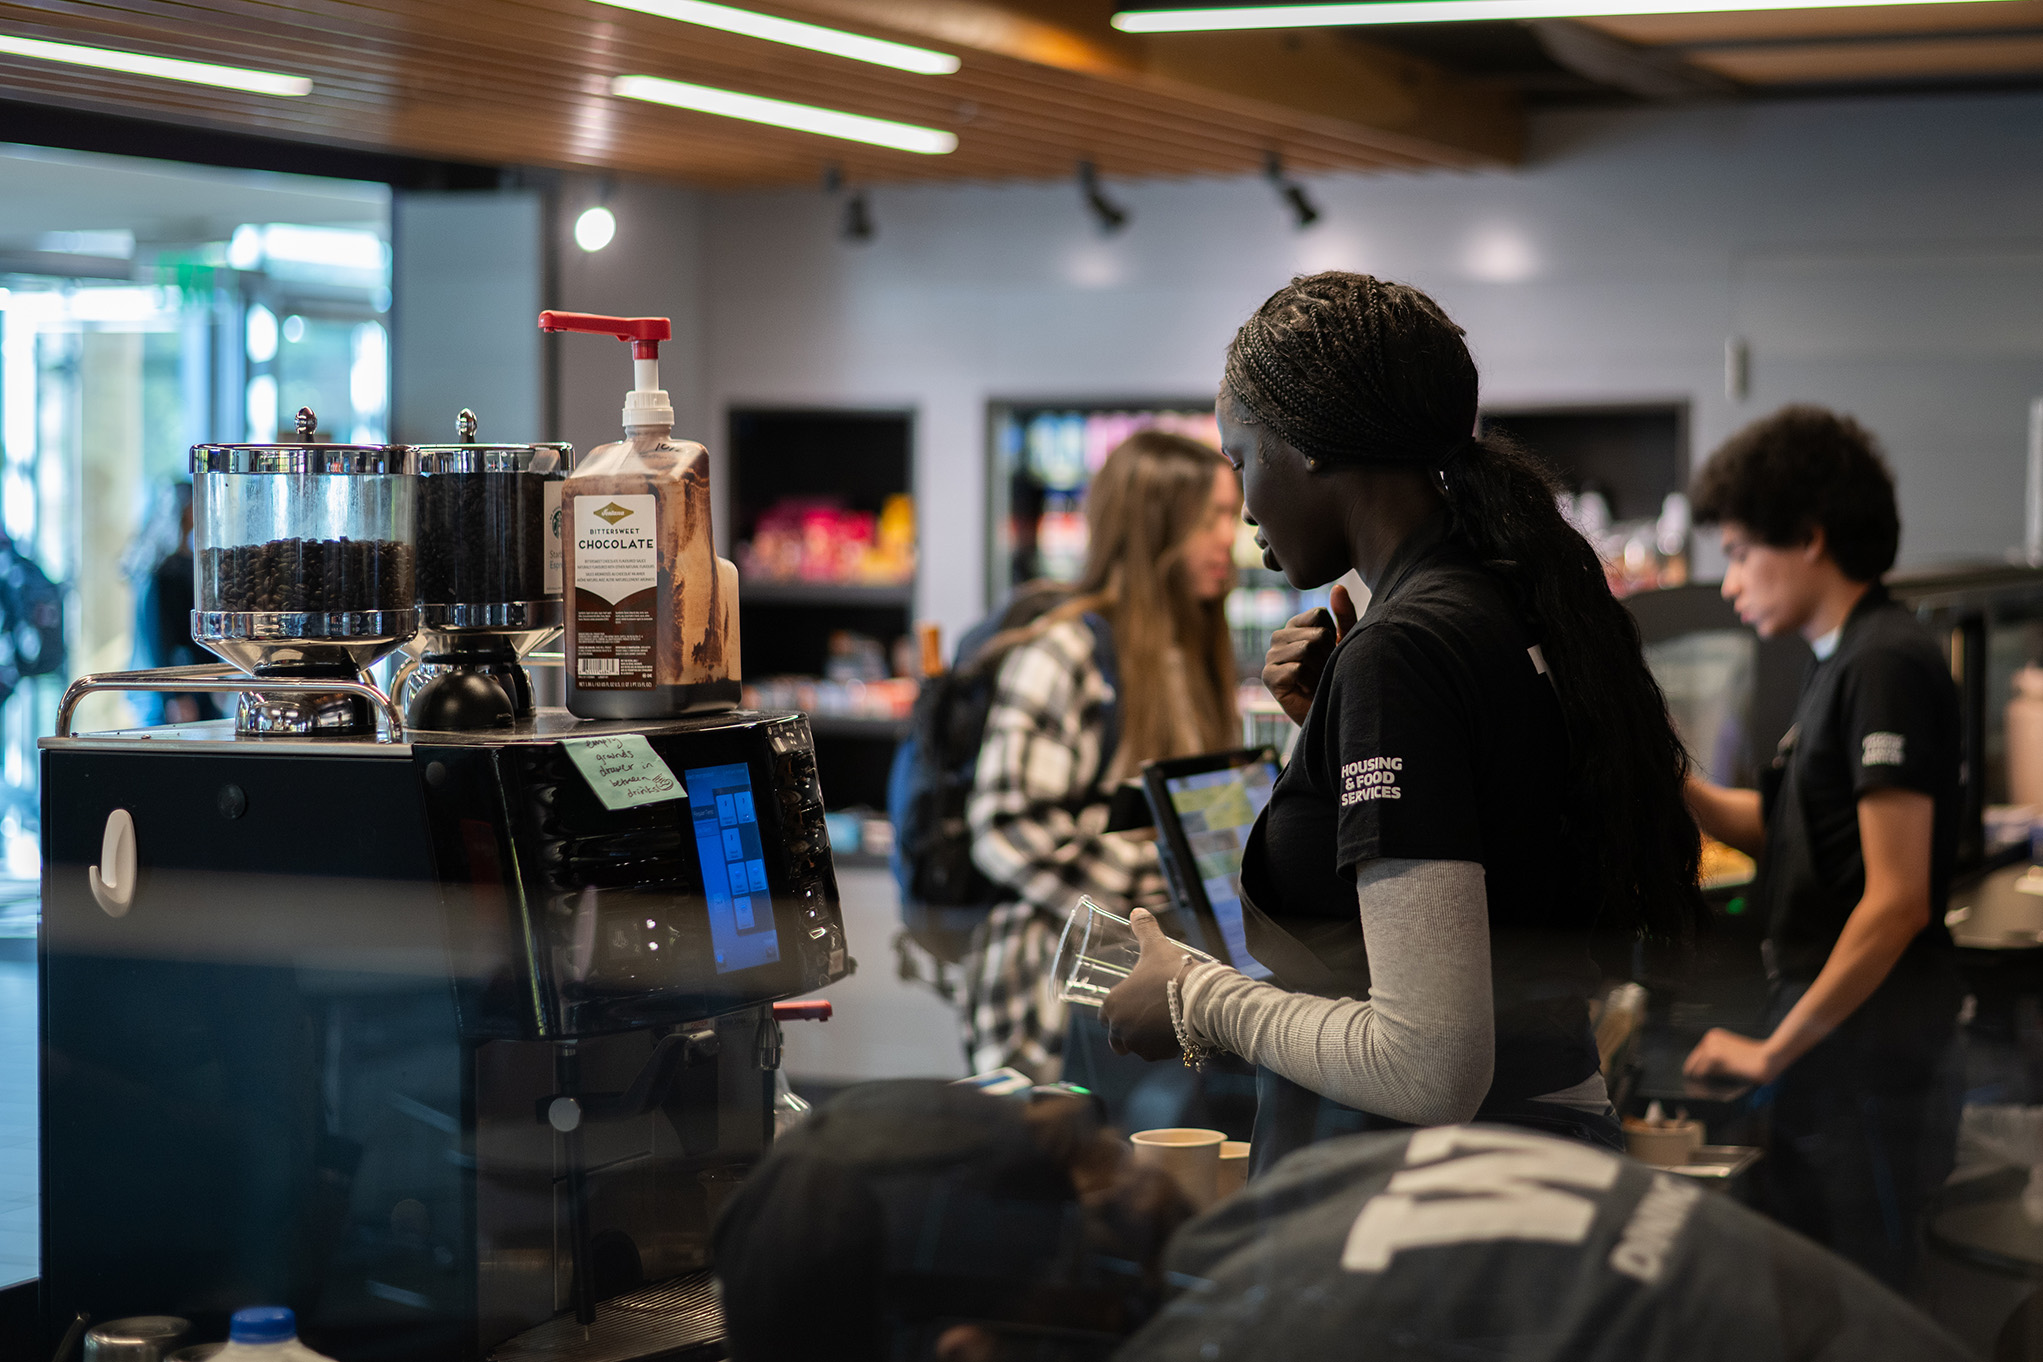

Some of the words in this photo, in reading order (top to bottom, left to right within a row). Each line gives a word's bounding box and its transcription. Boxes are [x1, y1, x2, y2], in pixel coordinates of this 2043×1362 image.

[578, 538, 654, 550] CHOCOLATE
[586, 737, 623, 749] empty
[599, 762, 634, 777] drawer
[642, 761, 654, 770] in
[1341, 757, 1402, 778] HOUSING
[1345, 777, 1355, 791] &
[1356, 771, 1395, 788] FOOD
[627, 785, 660, 798] drinks
[1341, 786, 1401, 806] SERVICES
